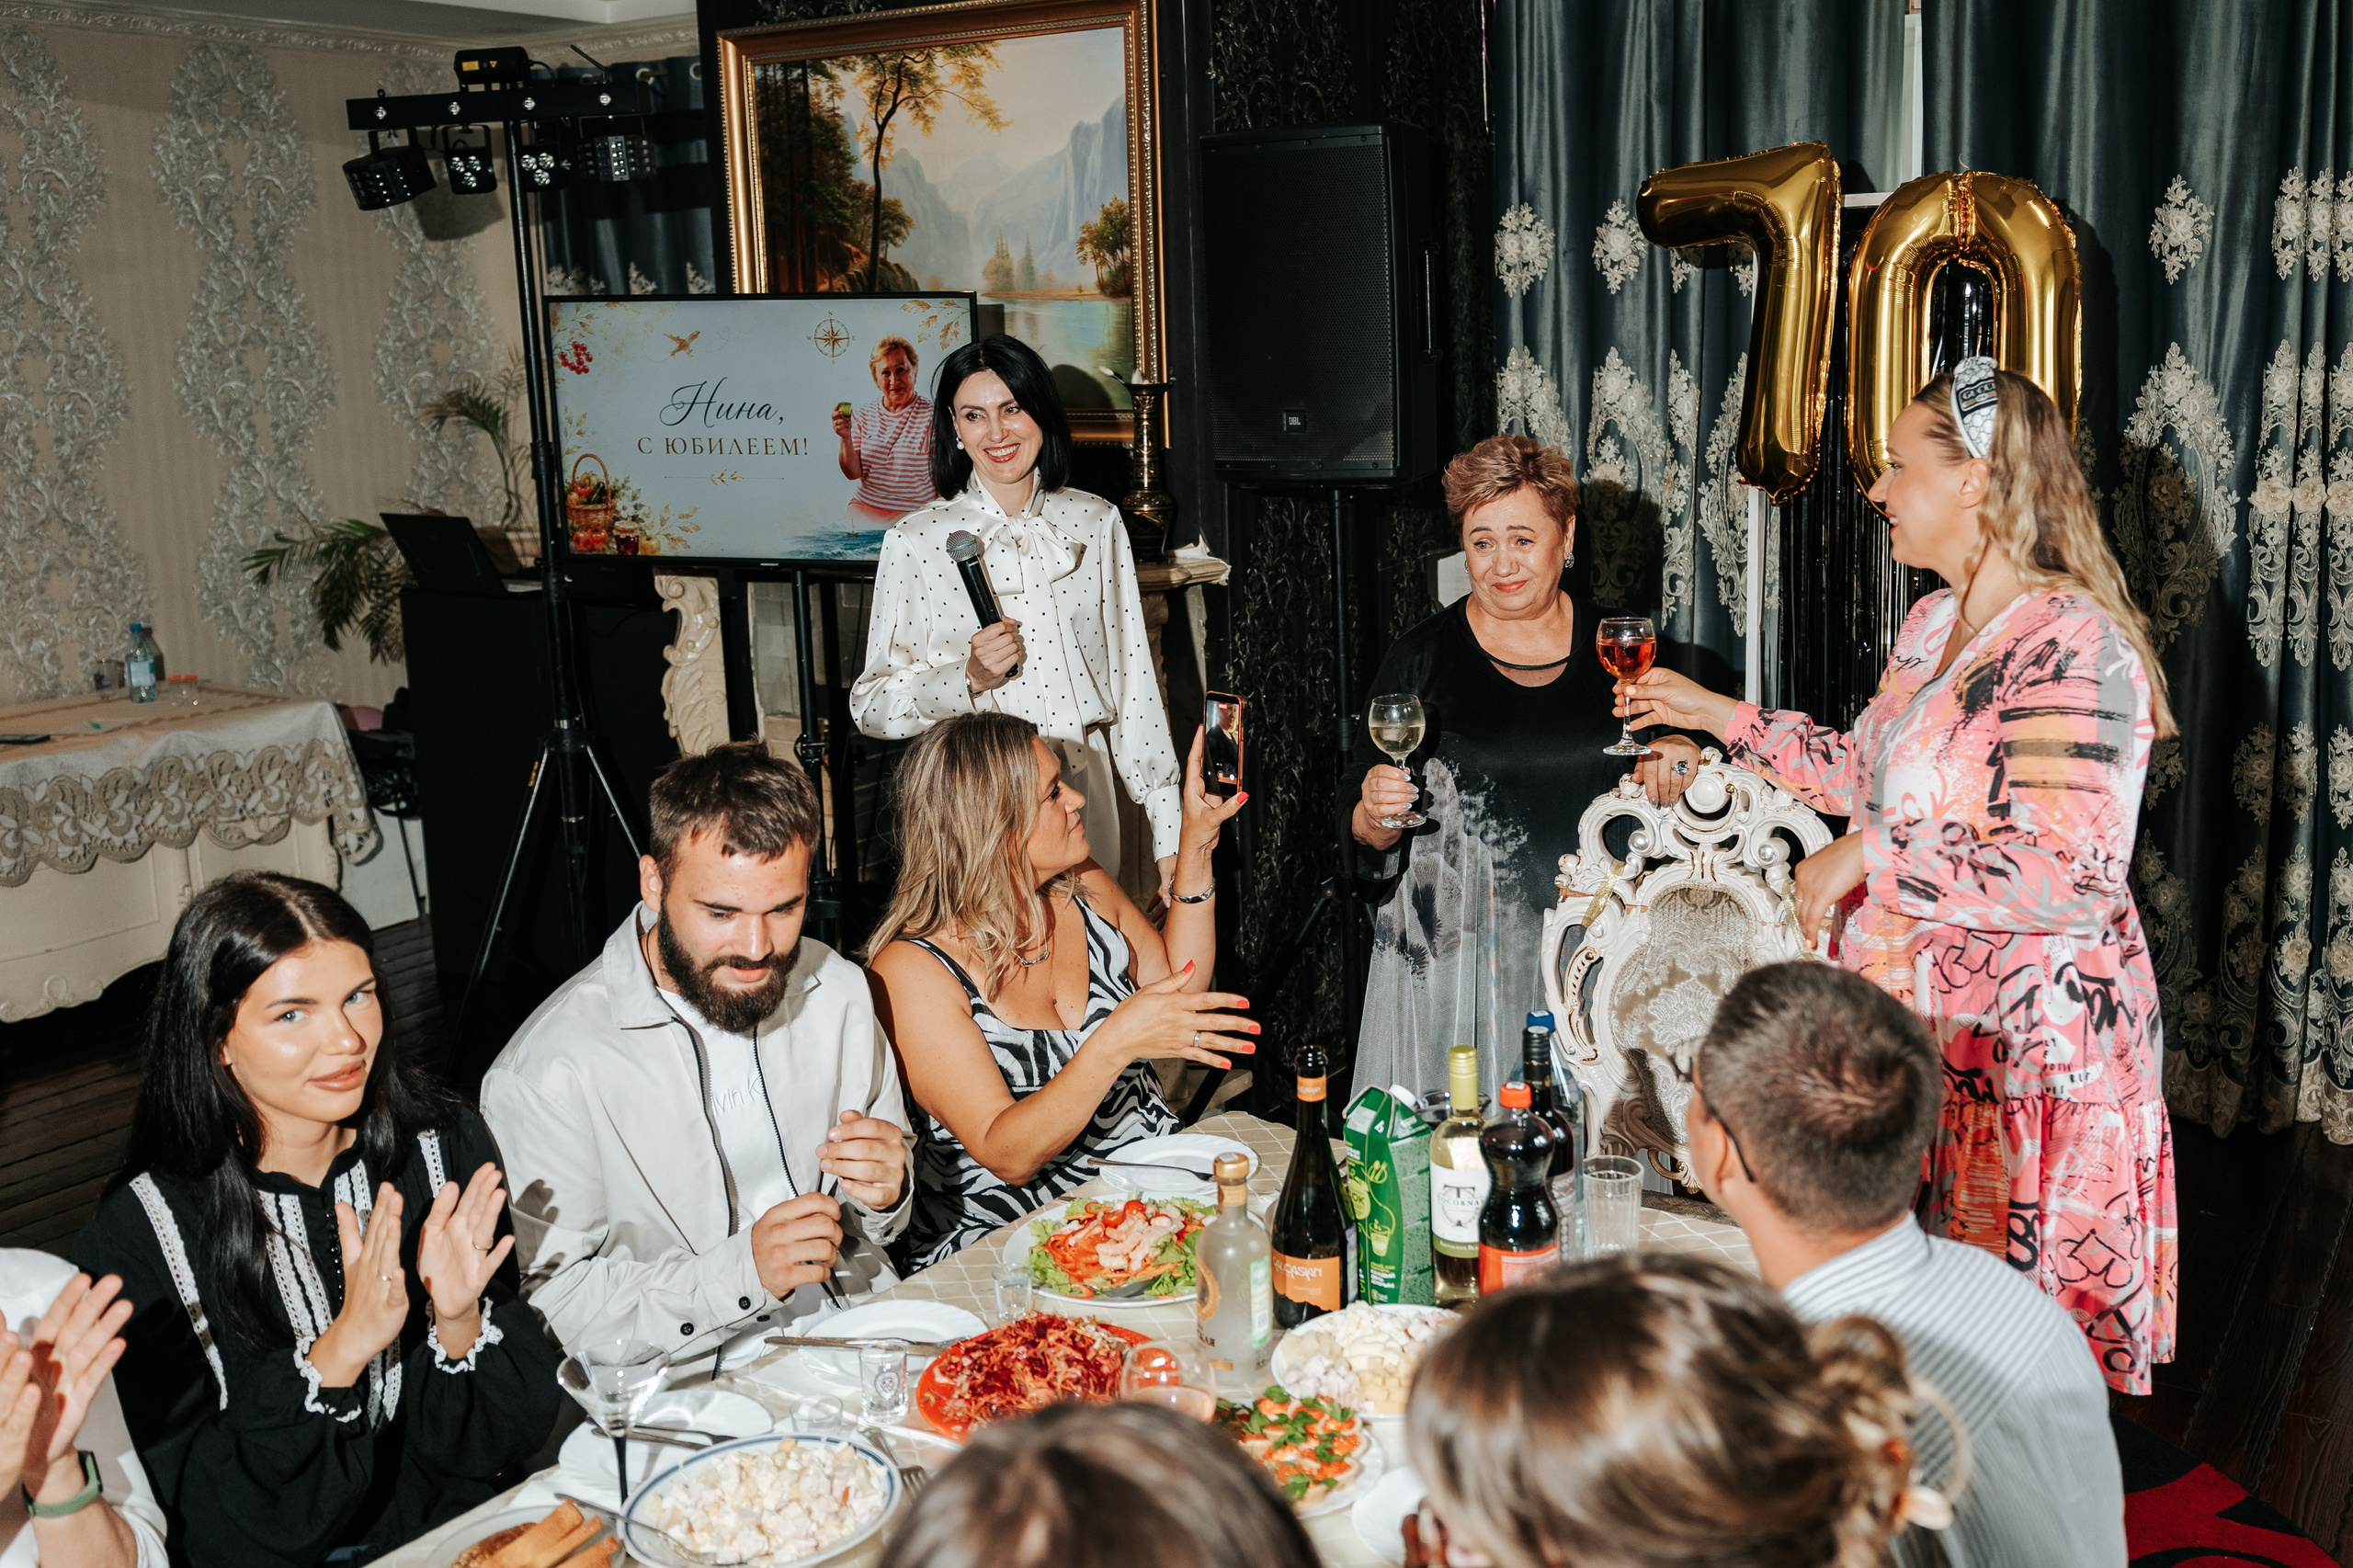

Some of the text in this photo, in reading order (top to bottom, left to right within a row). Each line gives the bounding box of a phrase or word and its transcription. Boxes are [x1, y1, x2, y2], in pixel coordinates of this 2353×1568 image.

[659, 377, 784, 428] Нина,
[1289, 416, 1302, 426] JBL
[637, 437, 808, 456] С ЮБИЛЕЕМ!
[710, 1087, 745, 1116] lvin
[1437, 1194, 1484, 1207] TOCORNA
